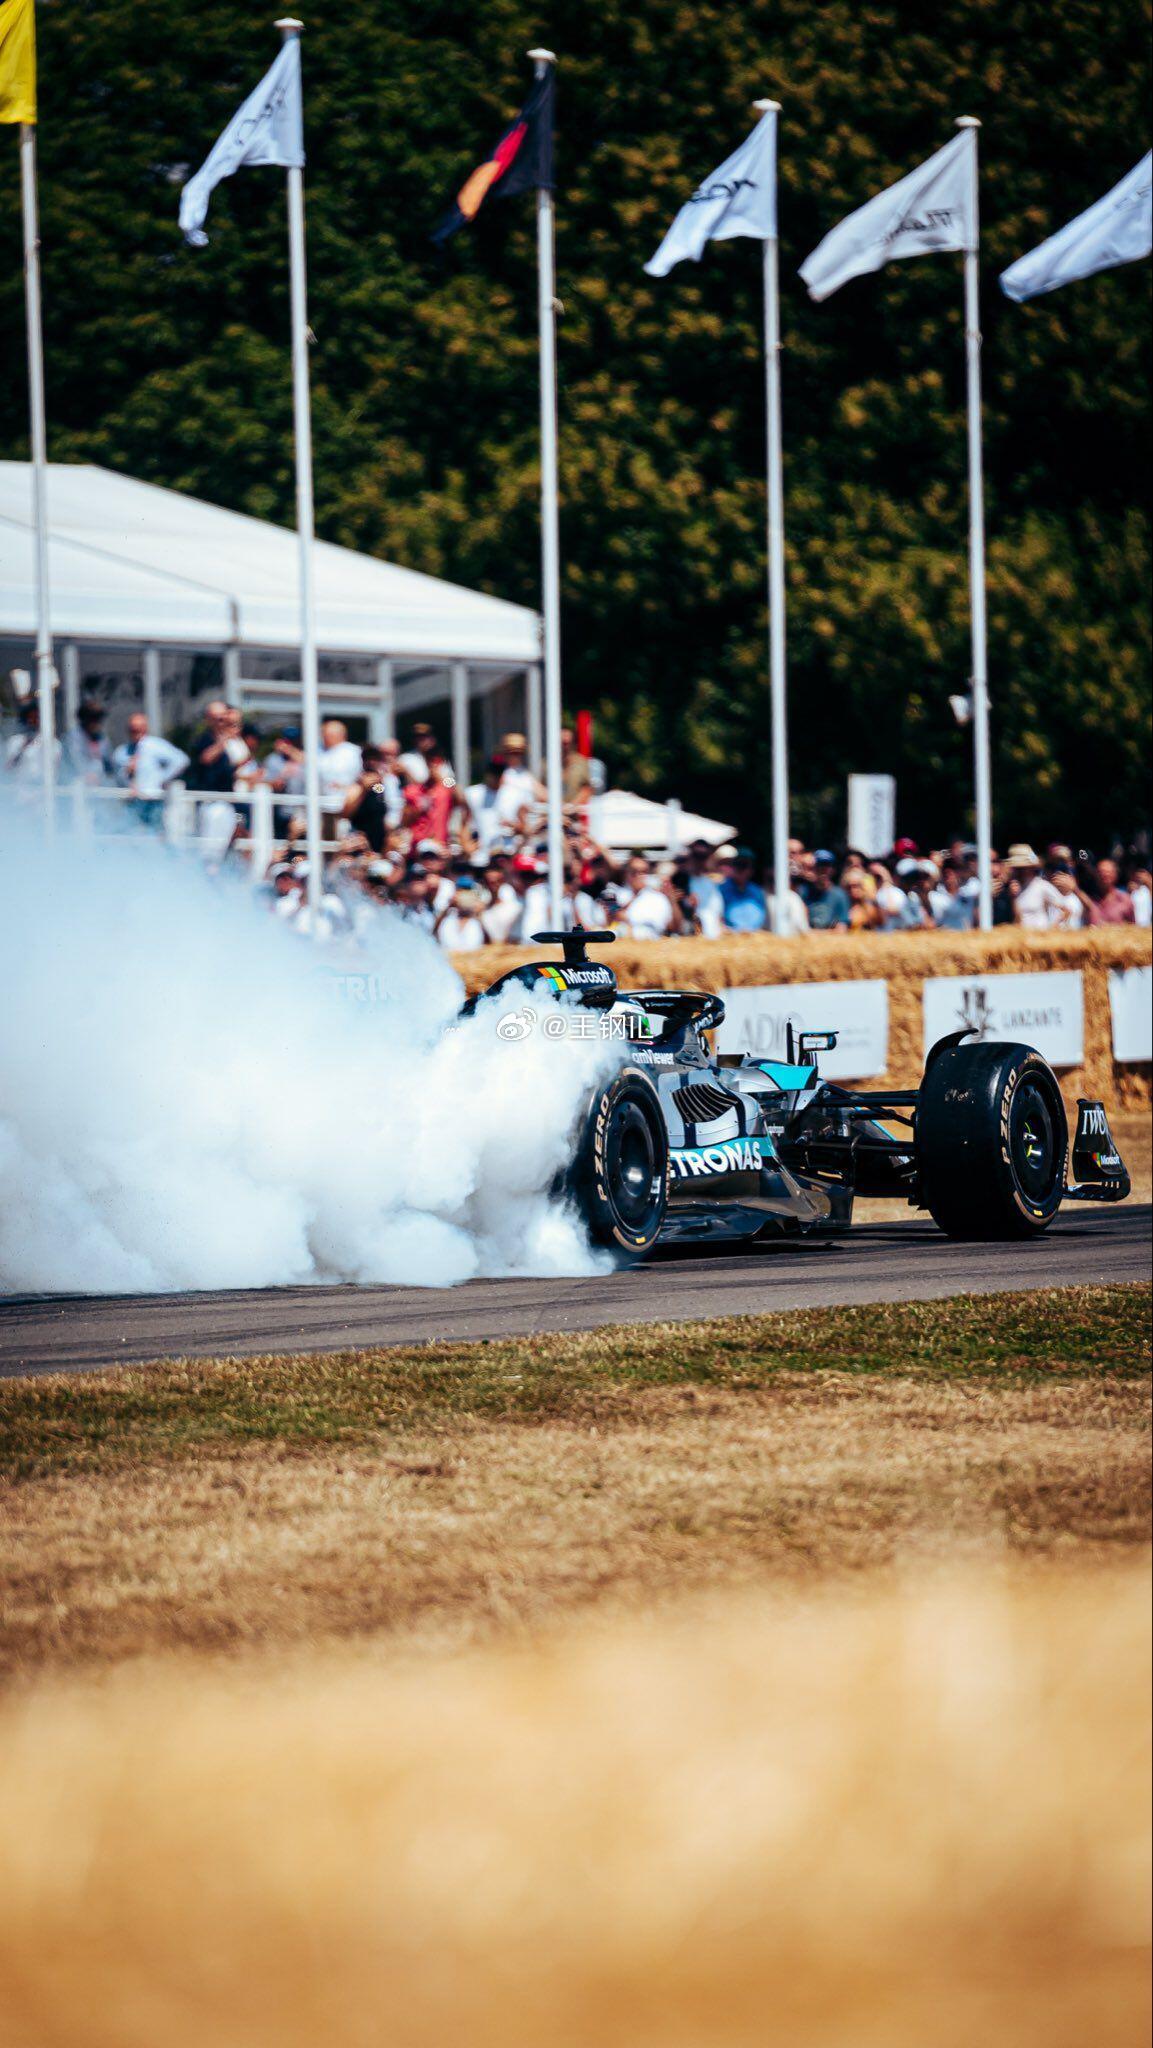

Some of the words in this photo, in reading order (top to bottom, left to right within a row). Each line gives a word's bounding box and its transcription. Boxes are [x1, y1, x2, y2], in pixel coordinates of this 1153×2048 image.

[560, 966, 612, 985] Microsoft
[594, 1093, 610, 1177] ZERO
[1000, 1068, 1017, 1141] ZERO
